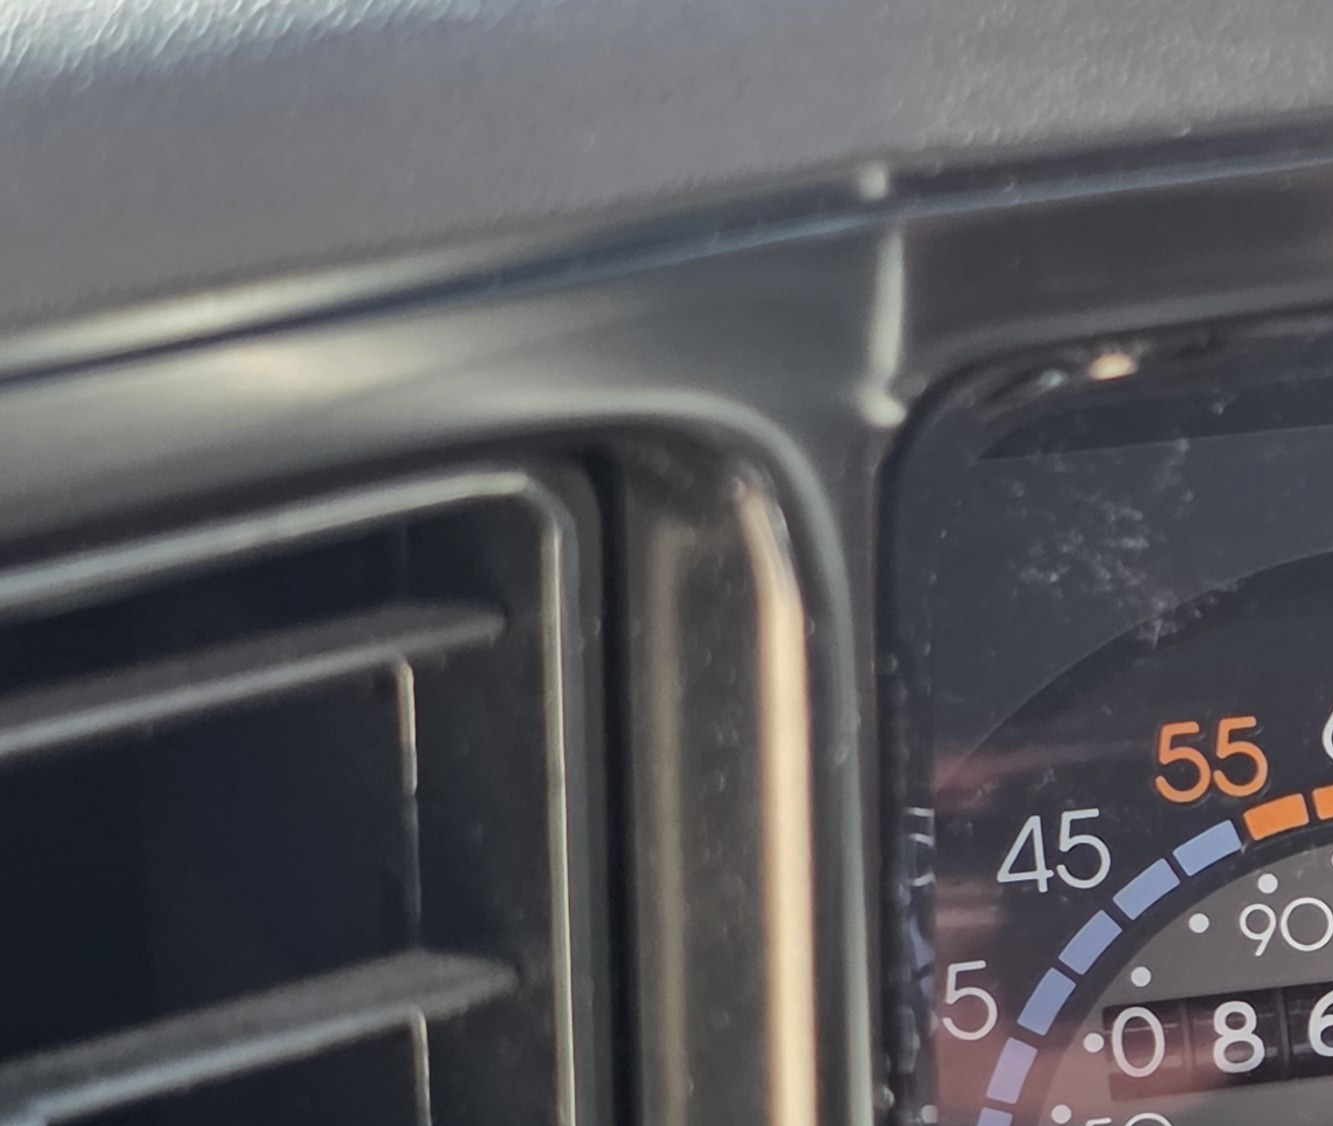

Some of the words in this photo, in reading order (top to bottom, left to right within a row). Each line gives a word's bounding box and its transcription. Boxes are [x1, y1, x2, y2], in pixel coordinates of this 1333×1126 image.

[1154, 716, 1269, 803] 55
[996, 808, 1112, 893] 45
[941, 959, 999, 1041] 5
